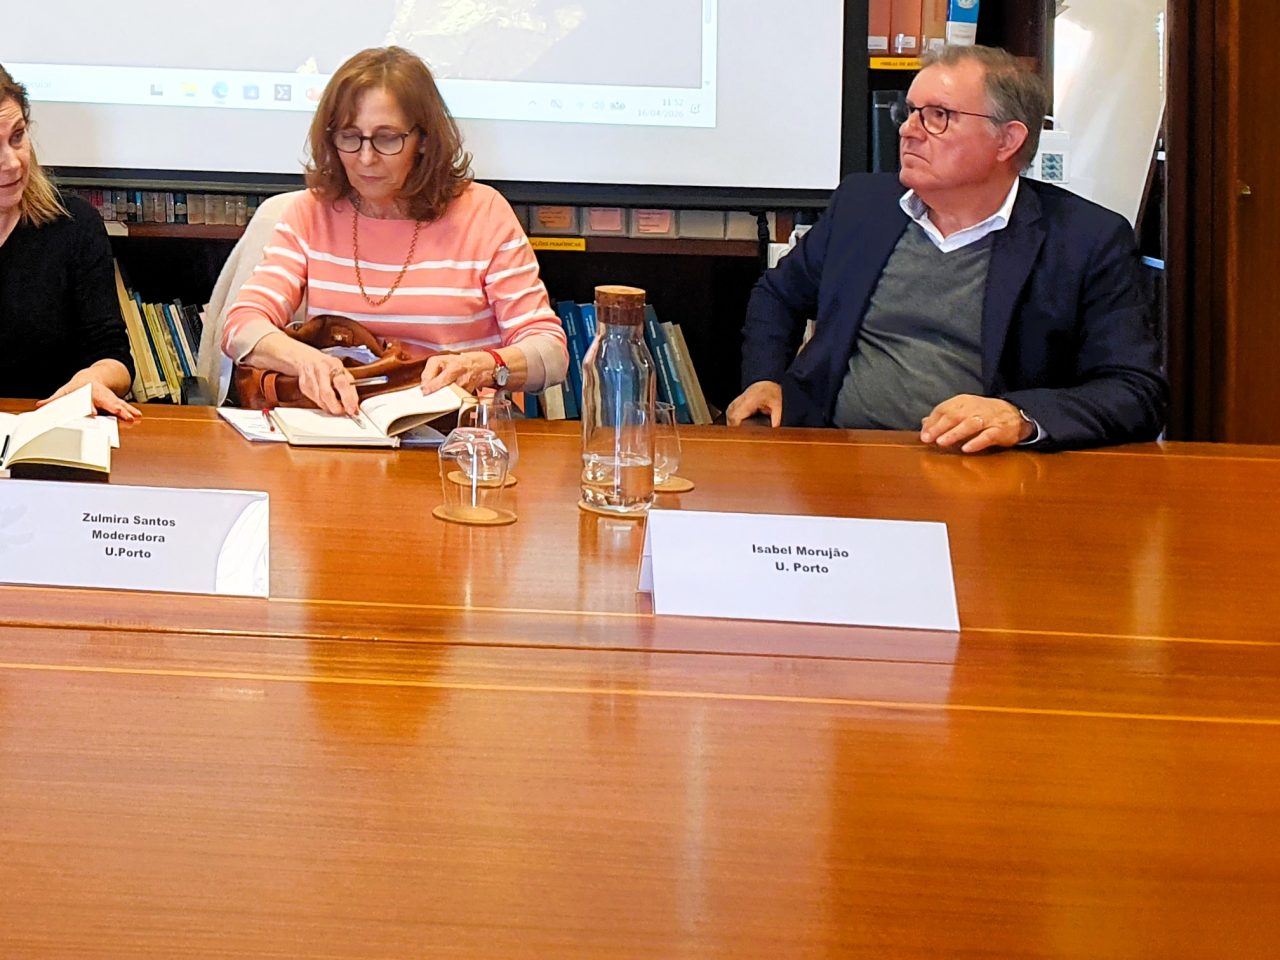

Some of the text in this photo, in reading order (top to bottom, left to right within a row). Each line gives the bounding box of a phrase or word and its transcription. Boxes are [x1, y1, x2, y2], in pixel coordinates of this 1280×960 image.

[82, 512, 176, 527] Zulmira Santos
[92, 529, 166, 543] Moderadora
[105, 547, 152, 558] U.Porto
[752, 544, 849, 559] Isabel Morujão
[775, 561, 829, 574] U. Porto
